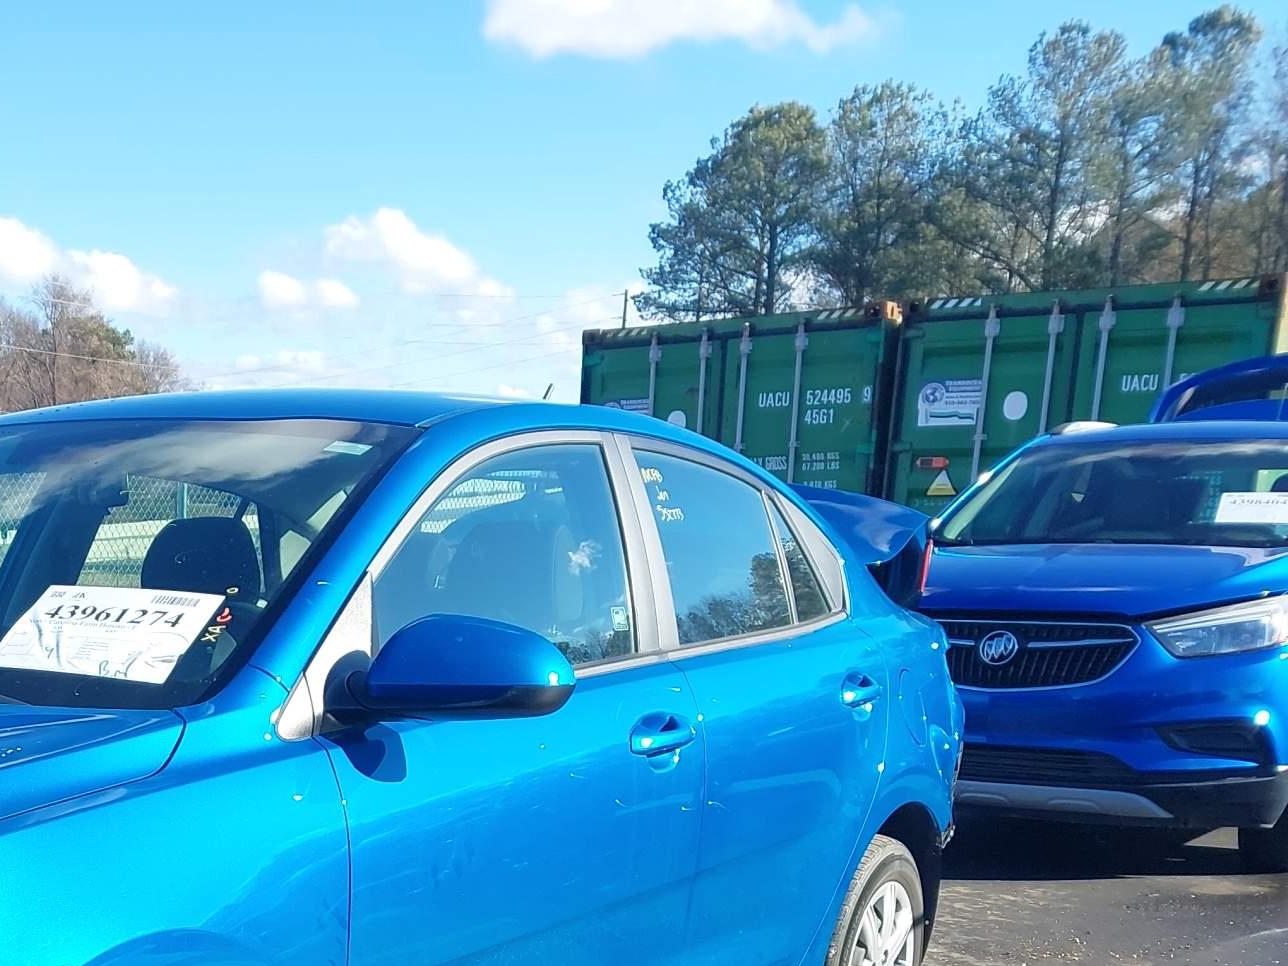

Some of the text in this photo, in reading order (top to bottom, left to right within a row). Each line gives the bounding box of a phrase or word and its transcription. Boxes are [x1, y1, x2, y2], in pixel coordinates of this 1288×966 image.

[1121, 374, 1159, 391] UACU
[758, 391, 790, 408] UACU
[863, 386, 872, 402] 9
[804, 408, 833, 425] 45G1
[765, 456, 787, 470] GROSS
[44, 604, 185, 629] 43961274
